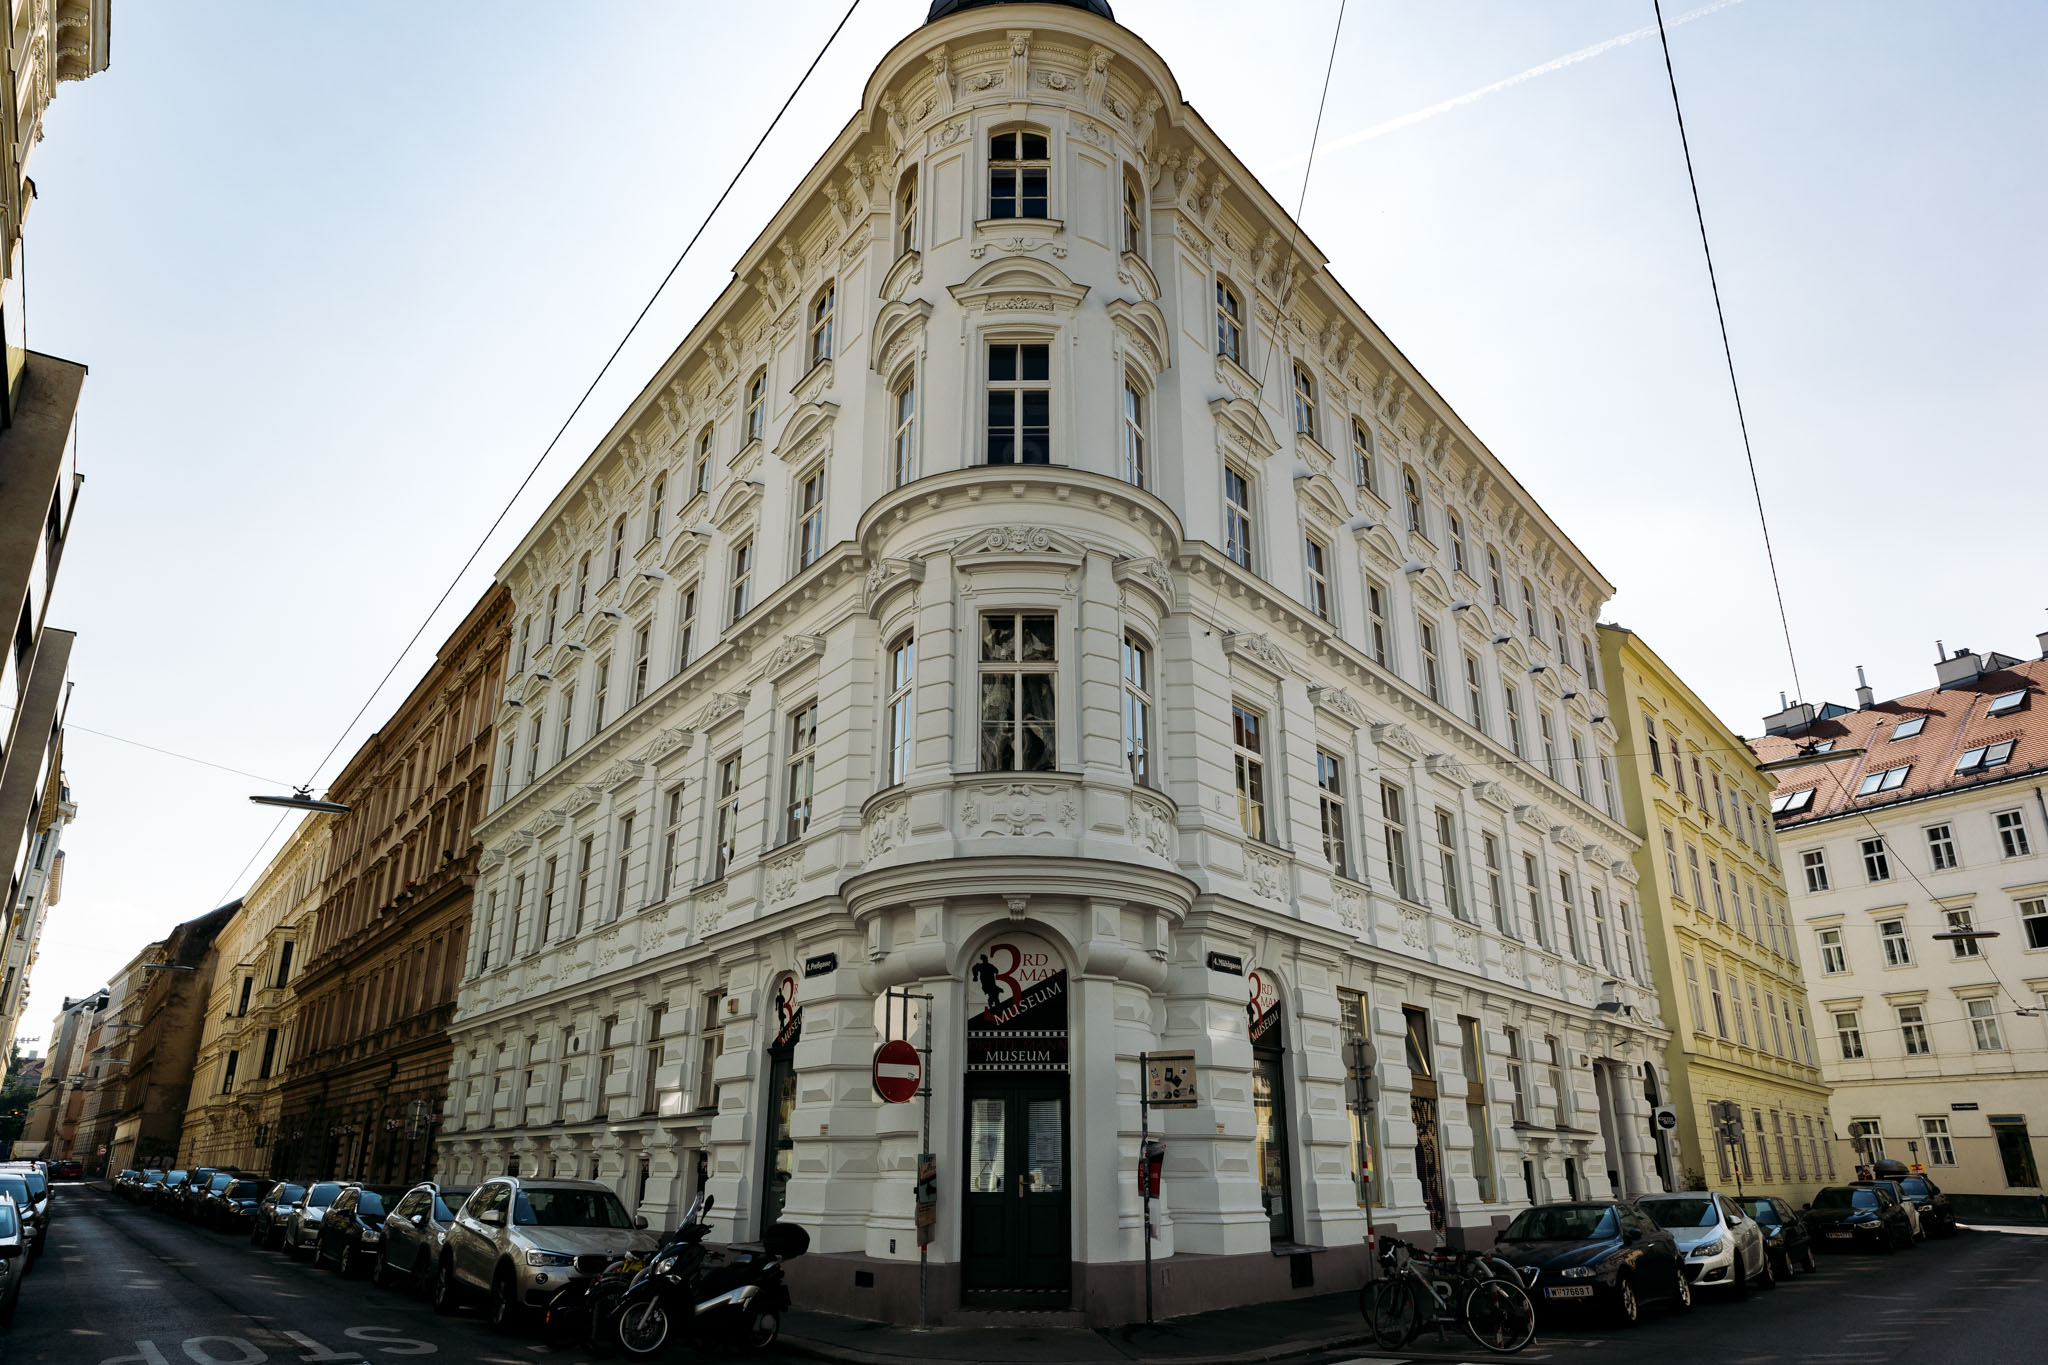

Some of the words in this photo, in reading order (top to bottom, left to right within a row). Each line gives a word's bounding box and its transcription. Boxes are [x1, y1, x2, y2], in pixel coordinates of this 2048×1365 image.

[1019, 968, 1065, 982] MAN
[993, 982, 1063, 1026] MUSEUM
[1251, 1010, 1280, 1042] MUSEUM
[986, 1050, 1051, 1062] MUSEUM
